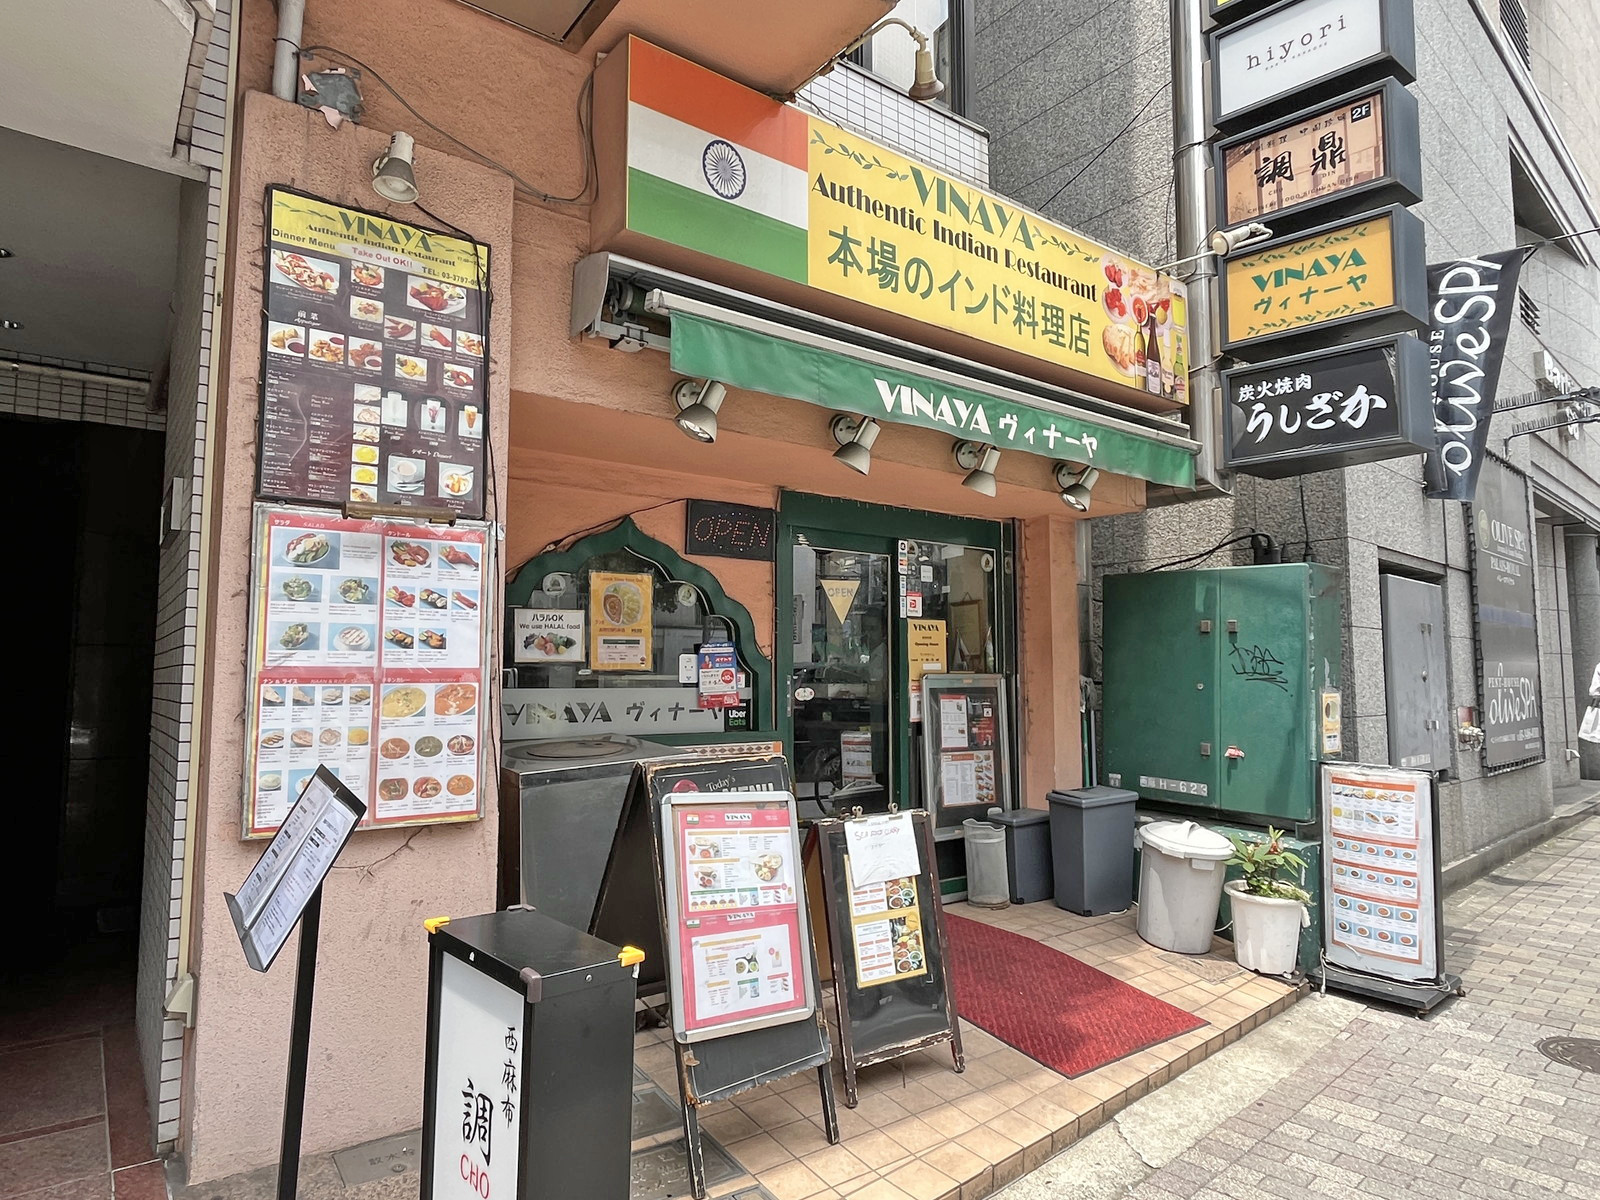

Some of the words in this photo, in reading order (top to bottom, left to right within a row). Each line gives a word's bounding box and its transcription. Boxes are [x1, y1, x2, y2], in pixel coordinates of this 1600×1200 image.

[1246, 15, 1347, 70] hiyori
[1352, 105, 1370, 119] 2F
[909, 166, 1035, 251] VINAYA
[272, 228, 306, 244] Dinner
[308, 237, 336, 251] Menu
[306, 223, 360, 243] Authentic
[363, 238, 399, 253] Indian
[401, 247, 456, 267] Restaurant
[339, 211, 432, 253] VINAYA
[811, 172, 927, 235] Authentic
[933, 219, 999, 263] Indian
[1004, 248, 1098, 303] Restaurant
[352, 246, 374, 260] Take
[375, 252, 391, 264] Out
[392, 257, 413, 269] OK!!
[422, 266, 440, 277] TEL:
[1252, 248, 1367, 293] VINAYA
[827, 225, 1091, 357] 本場のインド料理店
[1254, 273, 1368, 314] ヴィナーヤ
[1238, 372, 1313, 402] 炭火焼肉
[874, 378, 992, 435] VINAYA
[1246, 384, 1388, 444] うしざか
[999, 413, 1099, 459] ヴィナーヤ
[694, 516, 771, 548] OPEN
[1491, 519, 1514, 547] OLIVE
[827, 587, 854, 598] OPEN
[531, 613, 564, 623] ハラルOK
[913, 623, 939, 632] VINAYA
[503, 701, 612, 726] VINAYA
[728, 710, 746, 718] Uber
[728, 718, 746, 726] Eats
[706, 774, 736, 792] Today's
[1159, 778, 1208, 796] H-623
[728, 911, 754, 920] VINAYA
[500, 1026, 519, 1129] 西麻布
[461, 1077, 494, 1167] 調
[460, 1154, 490, 1199] CHO
